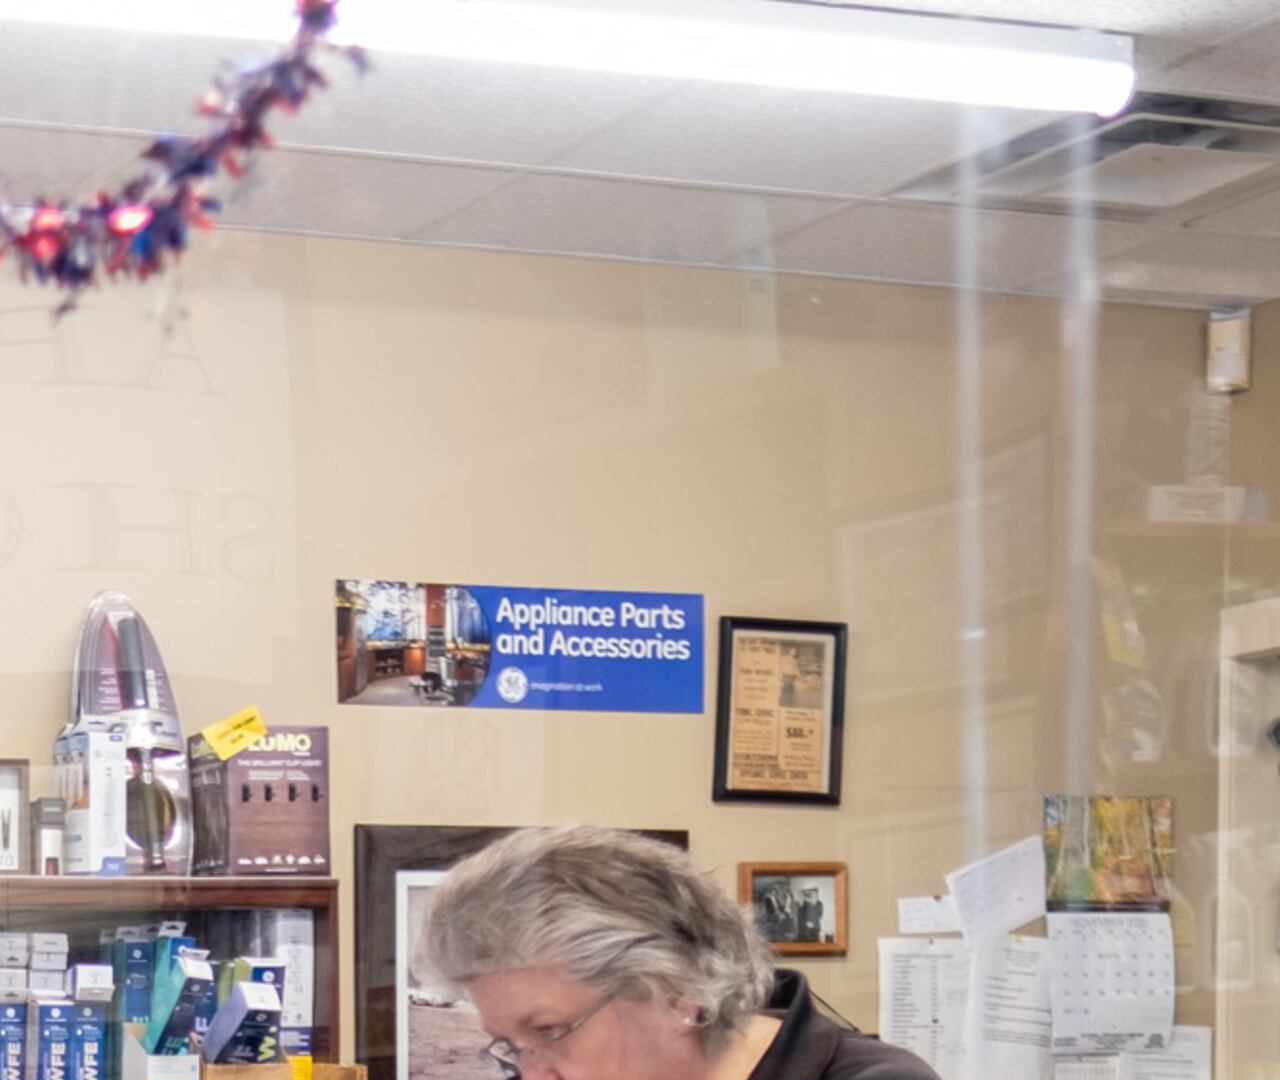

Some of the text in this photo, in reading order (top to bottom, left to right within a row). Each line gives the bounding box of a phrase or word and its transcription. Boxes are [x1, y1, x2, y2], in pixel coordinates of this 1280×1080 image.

[496, 597, 686, 631] Appliance Parts
[496, 628, 691, 661] and Accessories
